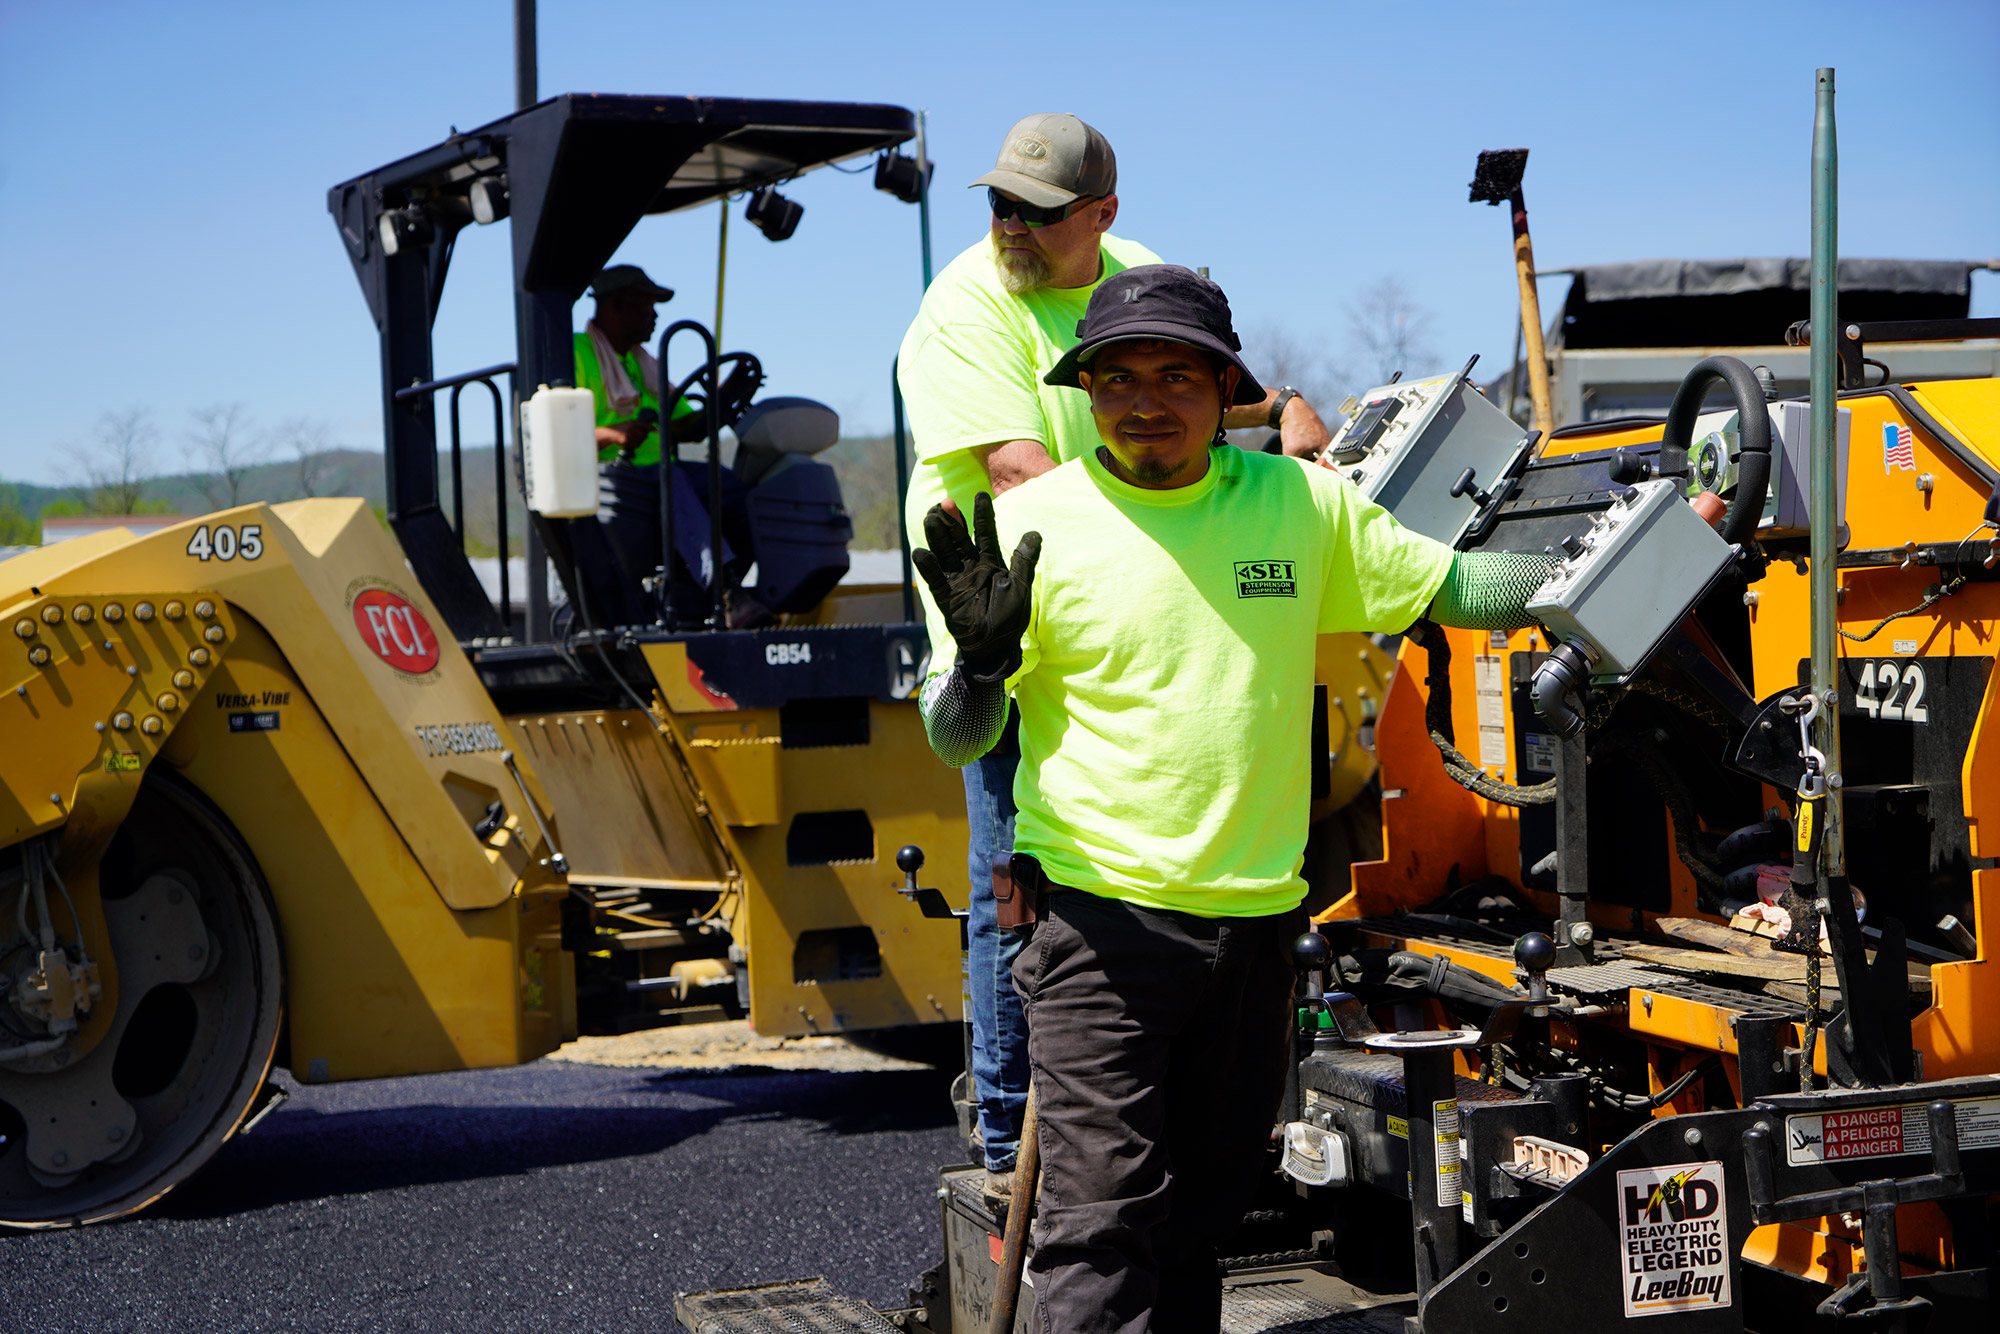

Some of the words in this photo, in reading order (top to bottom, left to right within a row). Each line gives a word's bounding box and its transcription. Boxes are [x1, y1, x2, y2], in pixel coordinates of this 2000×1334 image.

[187, 525, 264, 562] 405
[1250, 563, 1294, 580] SEI
[363, 605, 427, 657] FCI
[765, 643, 811, 665] CB54
[1856, 660, 1928, 723] 422
[1800, 815, 1810, 839] Purdy
[1840, 1111, 1897, 1127] DANGER
[1841, 1125, 1900, 1141] PELIGRO
[1841, 1140, 1899, 1156] DANGER
[1627, 1223, 1677, 1240] HEAVY
[1679, 1220, 1720, 1235] DUTY
[1628, 1233, 1722, 1256] ELECTRIC
[1629, 1248, 1723, 1274] LEGEND
[1631, 1270, 1725, 1303] LeeBoy
